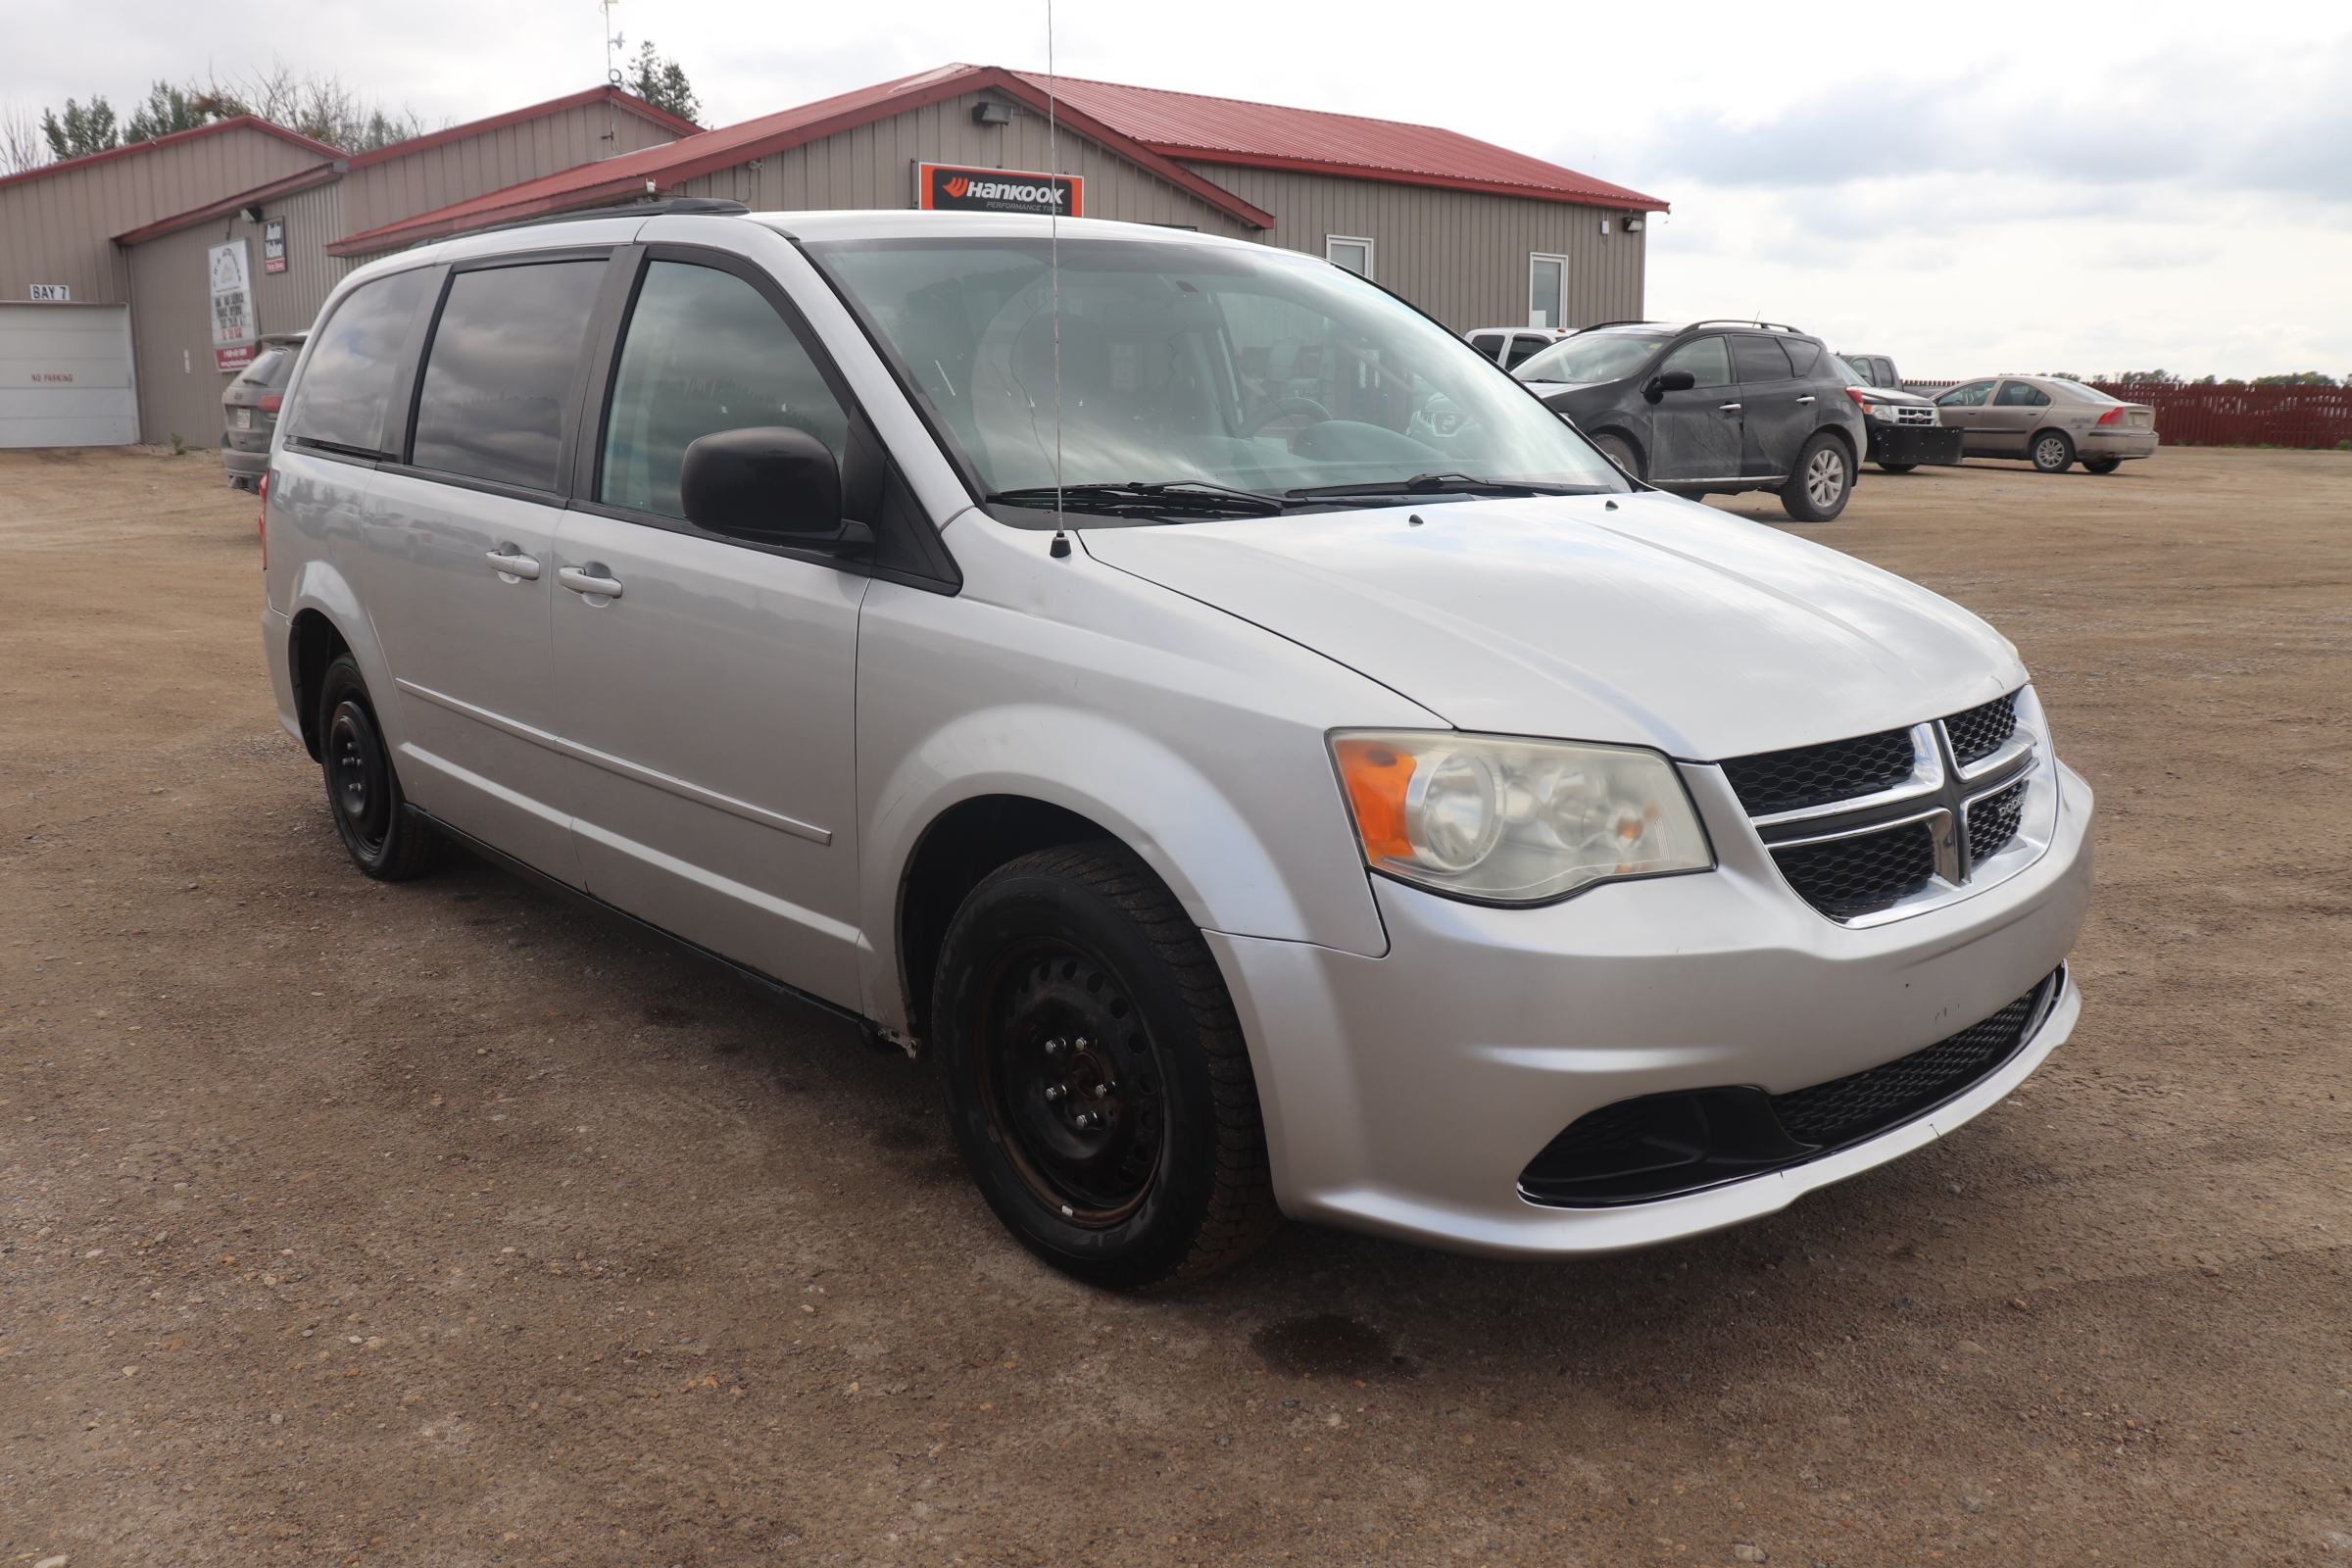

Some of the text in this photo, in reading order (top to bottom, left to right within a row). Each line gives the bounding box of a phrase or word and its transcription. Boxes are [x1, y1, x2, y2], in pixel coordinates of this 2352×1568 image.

[986, 201, 1041, 212] PERFORMANCE
[267, 223, 280, 240] Auto
[266, 241, 282, 258] Value
[32, 285, 67, 299] BAY 7
[30, 373, 73, 382] NO PARKING
[1999, 792, 2026, 817] DODGE
